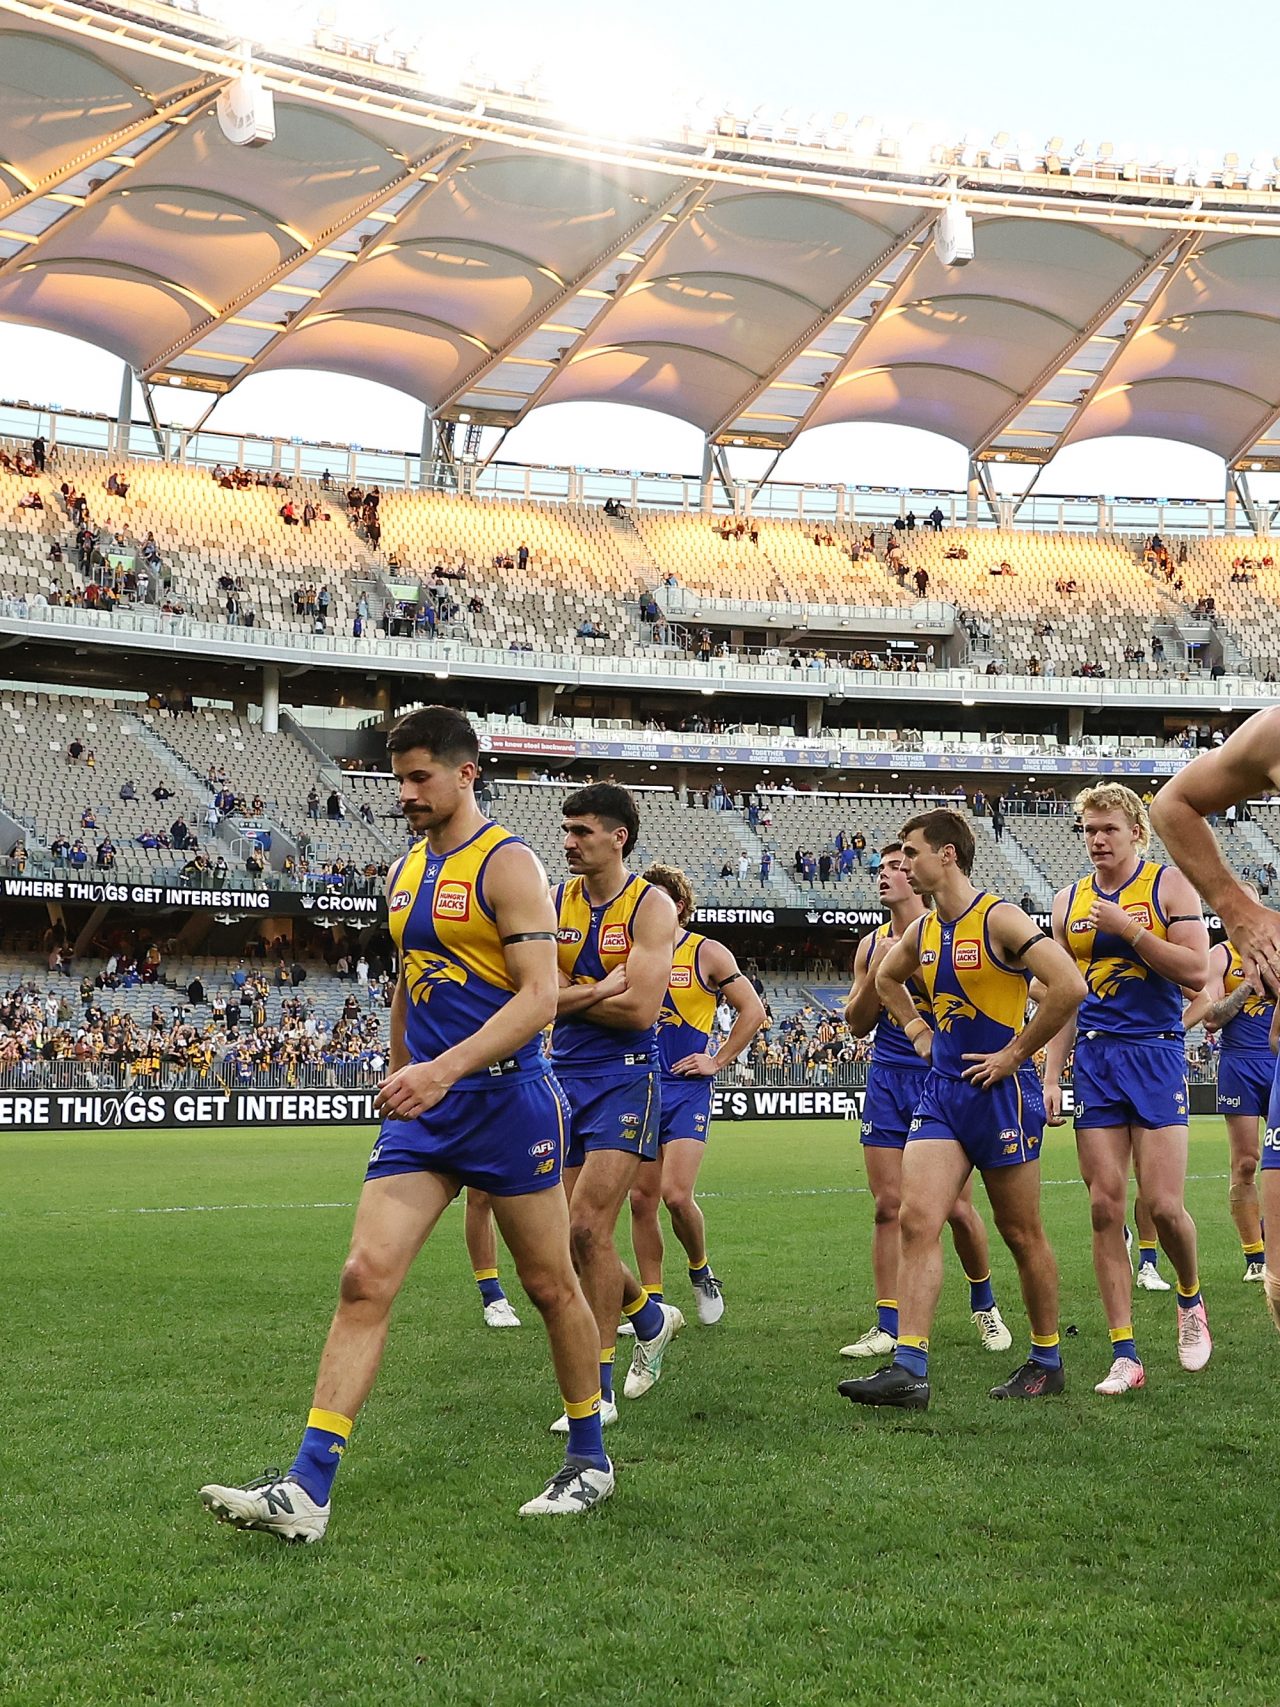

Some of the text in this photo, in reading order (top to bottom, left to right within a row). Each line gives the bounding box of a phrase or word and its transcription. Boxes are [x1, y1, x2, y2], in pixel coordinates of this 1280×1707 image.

[541, 744, 576, 752] backwards
[5, 880, 270, 908] WHERE THINGS GET INTERESTING
[439, 891, 465, 899] HUNGRY
[316, 896, 377, 912] CROWN
[438, 899, 464, 909] JACK'S
[691, 908, 775, 924] TERESTING
[822, 911, 883, 925] CROWN
[557, 931, 578, 940] AFL
[0, 1091, 381, 1126] ERE THINGS GET INTERESTI
[754, 1092, 847, 1115] WHERE
[1227, 1096, 1241, 1108] agl
[1075, 1102, 1085, 1118] gl
[620, 1114, 640, 1125] AFL
[1000, 1129, 1018, 1140] AFL
[531, 1142, 555, 1158] AFL
